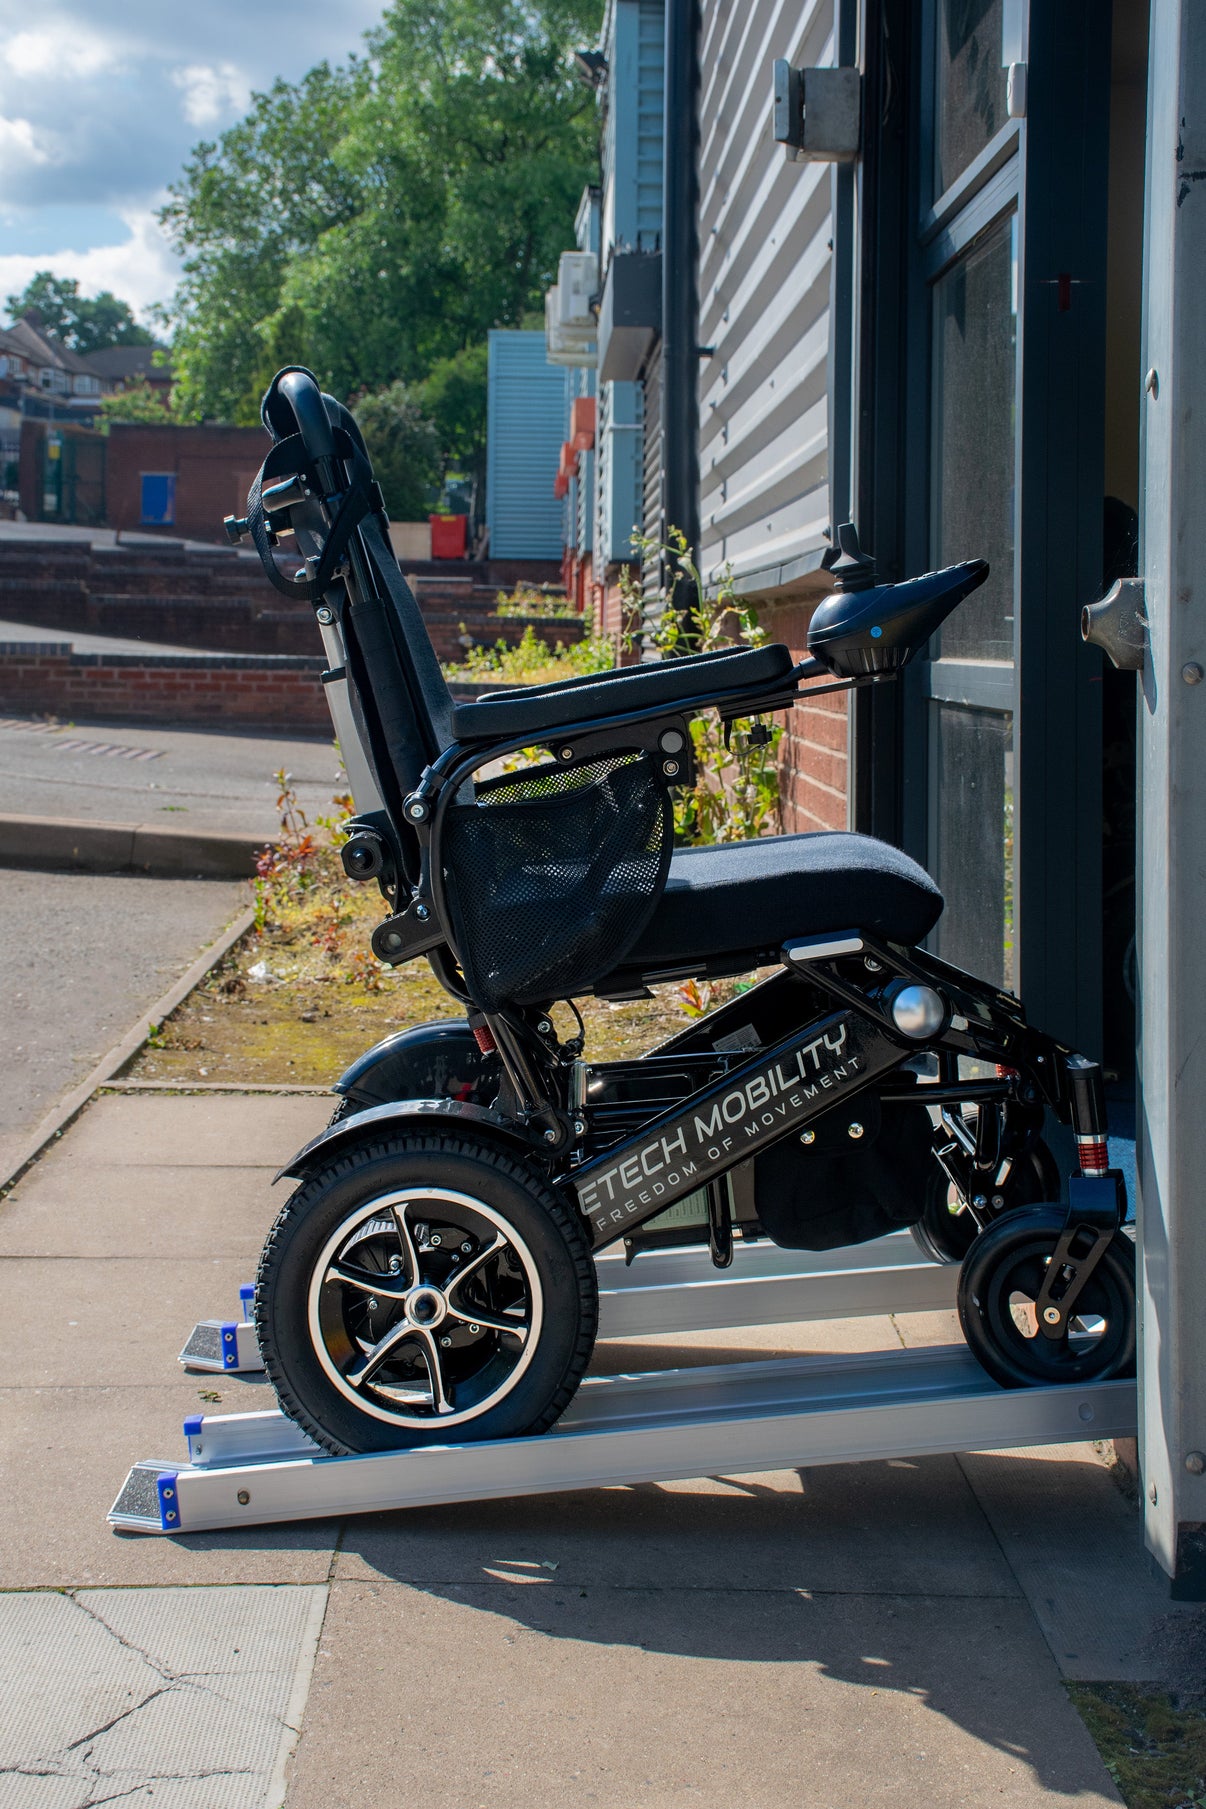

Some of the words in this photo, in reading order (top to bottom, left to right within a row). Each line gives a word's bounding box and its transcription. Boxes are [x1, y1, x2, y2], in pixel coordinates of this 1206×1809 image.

[578, 1127, 687, 1216] ETECH
[694, 1023, 847, 1144] MOBILITY
[596, 1161, 698, 1232] FREEDOM
[707, 1137, 733, 1160] OF
[744, 1057, 860, 1137] MOVEMENT
